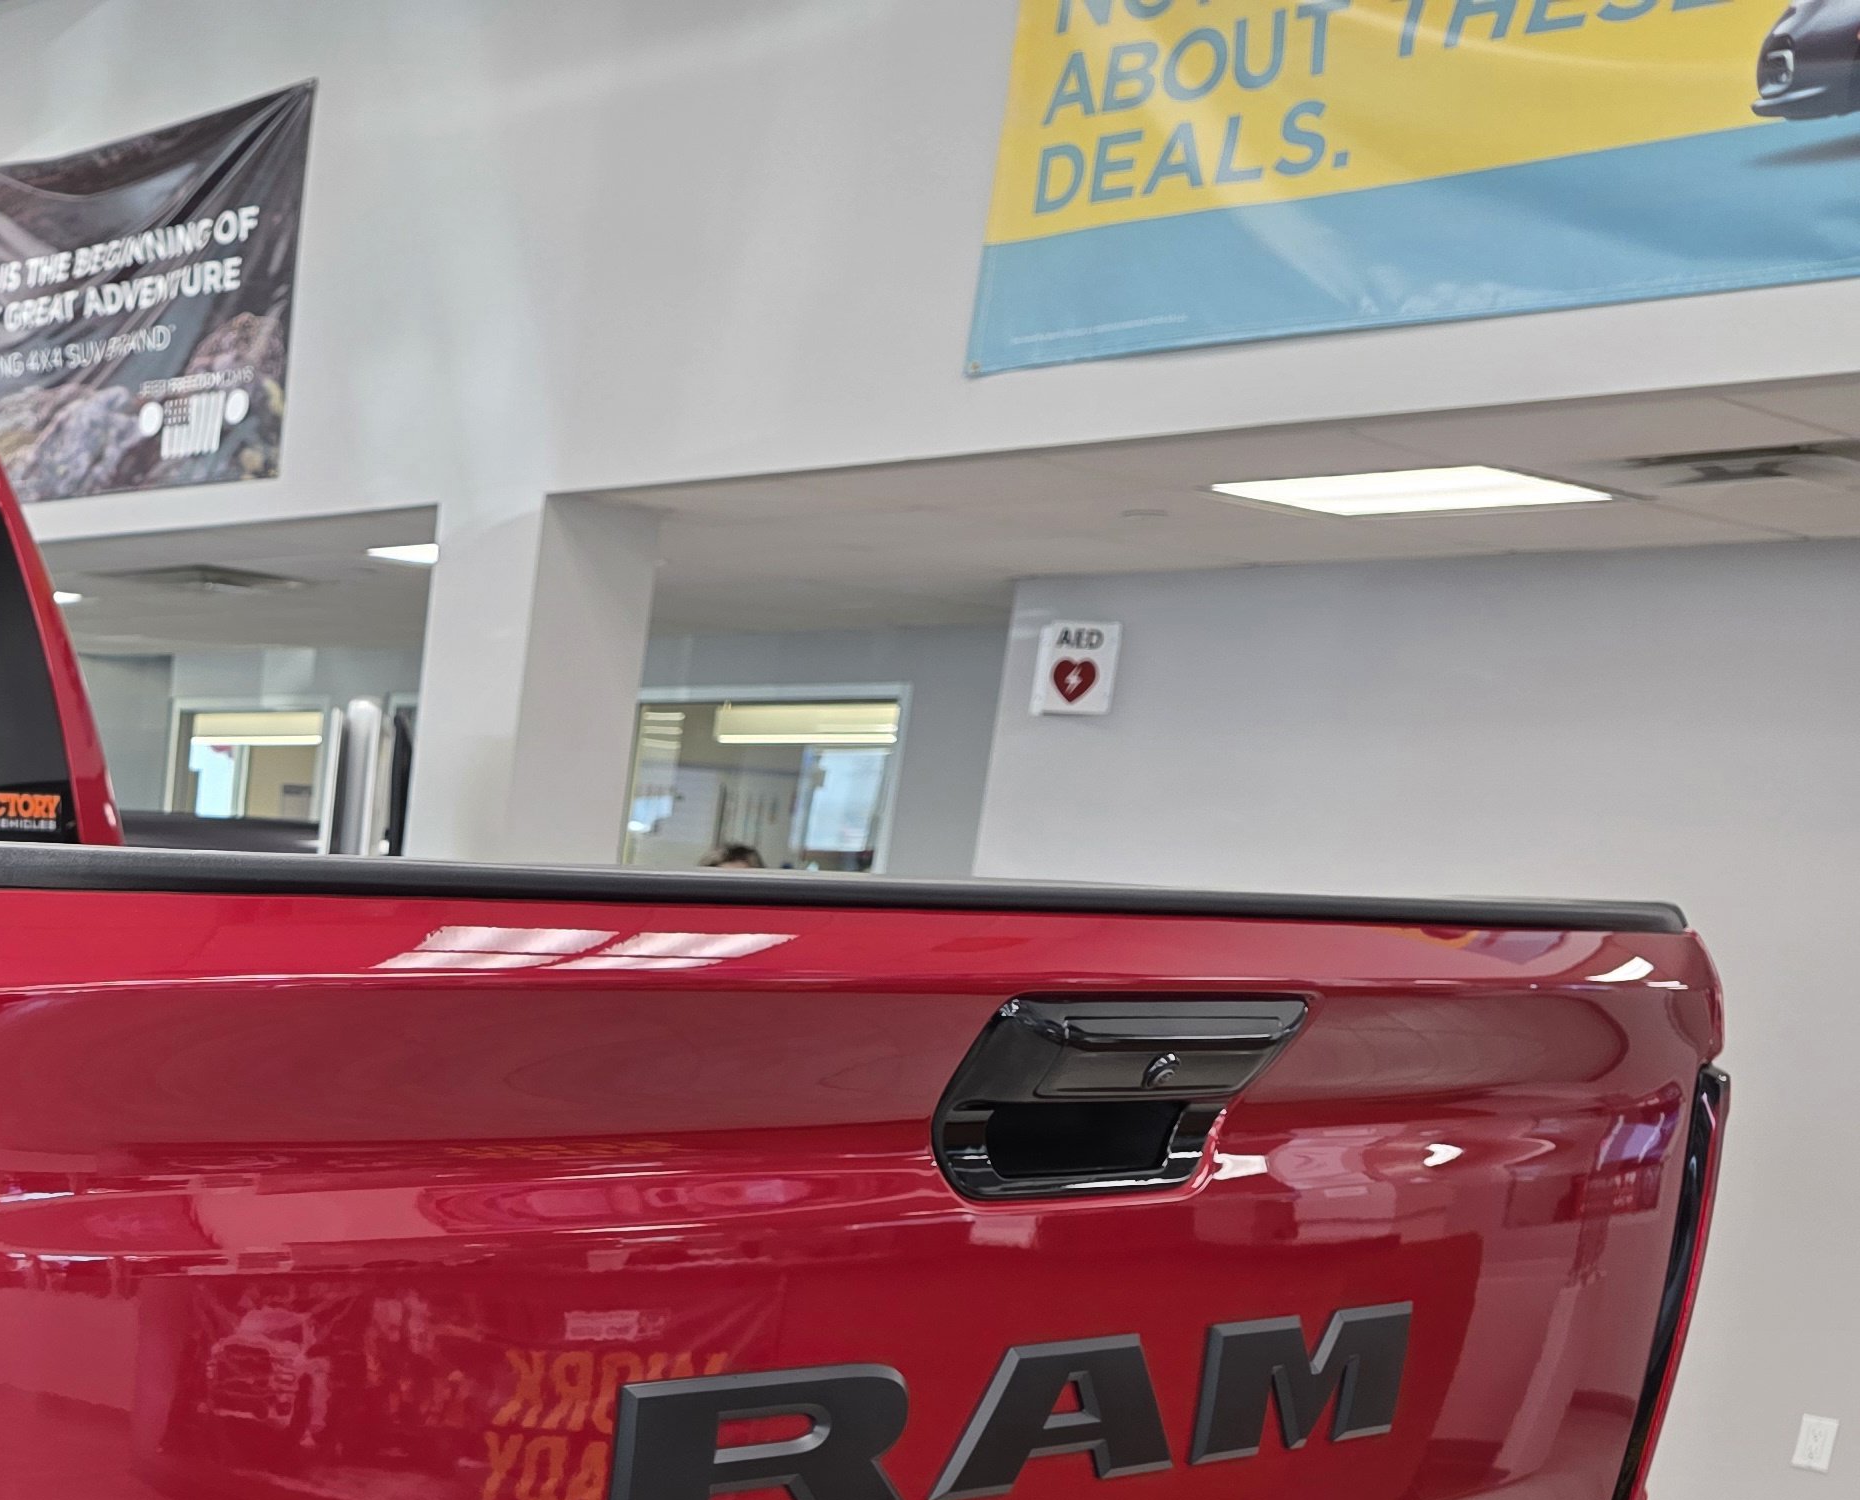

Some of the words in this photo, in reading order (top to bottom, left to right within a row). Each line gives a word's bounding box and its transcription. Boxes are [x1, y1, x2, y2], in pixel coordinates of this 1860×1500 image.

[1042, 0, 1352, 126] ABOUT
[1399, 0, 1736, 57] THE
[1033, 100, 1352, 216] DEALS.
[25, 251, 72, 288] THE
[72, 218, 214, 280] BEGINNING
[213, 205, 260, 245] OF
[4, 290, 79, 332] GREAT
[83, 256, 243, 319] ADVENTURE
[64, 340, 106, 369] SUV
[1056, 626, 1106, 650] AED
